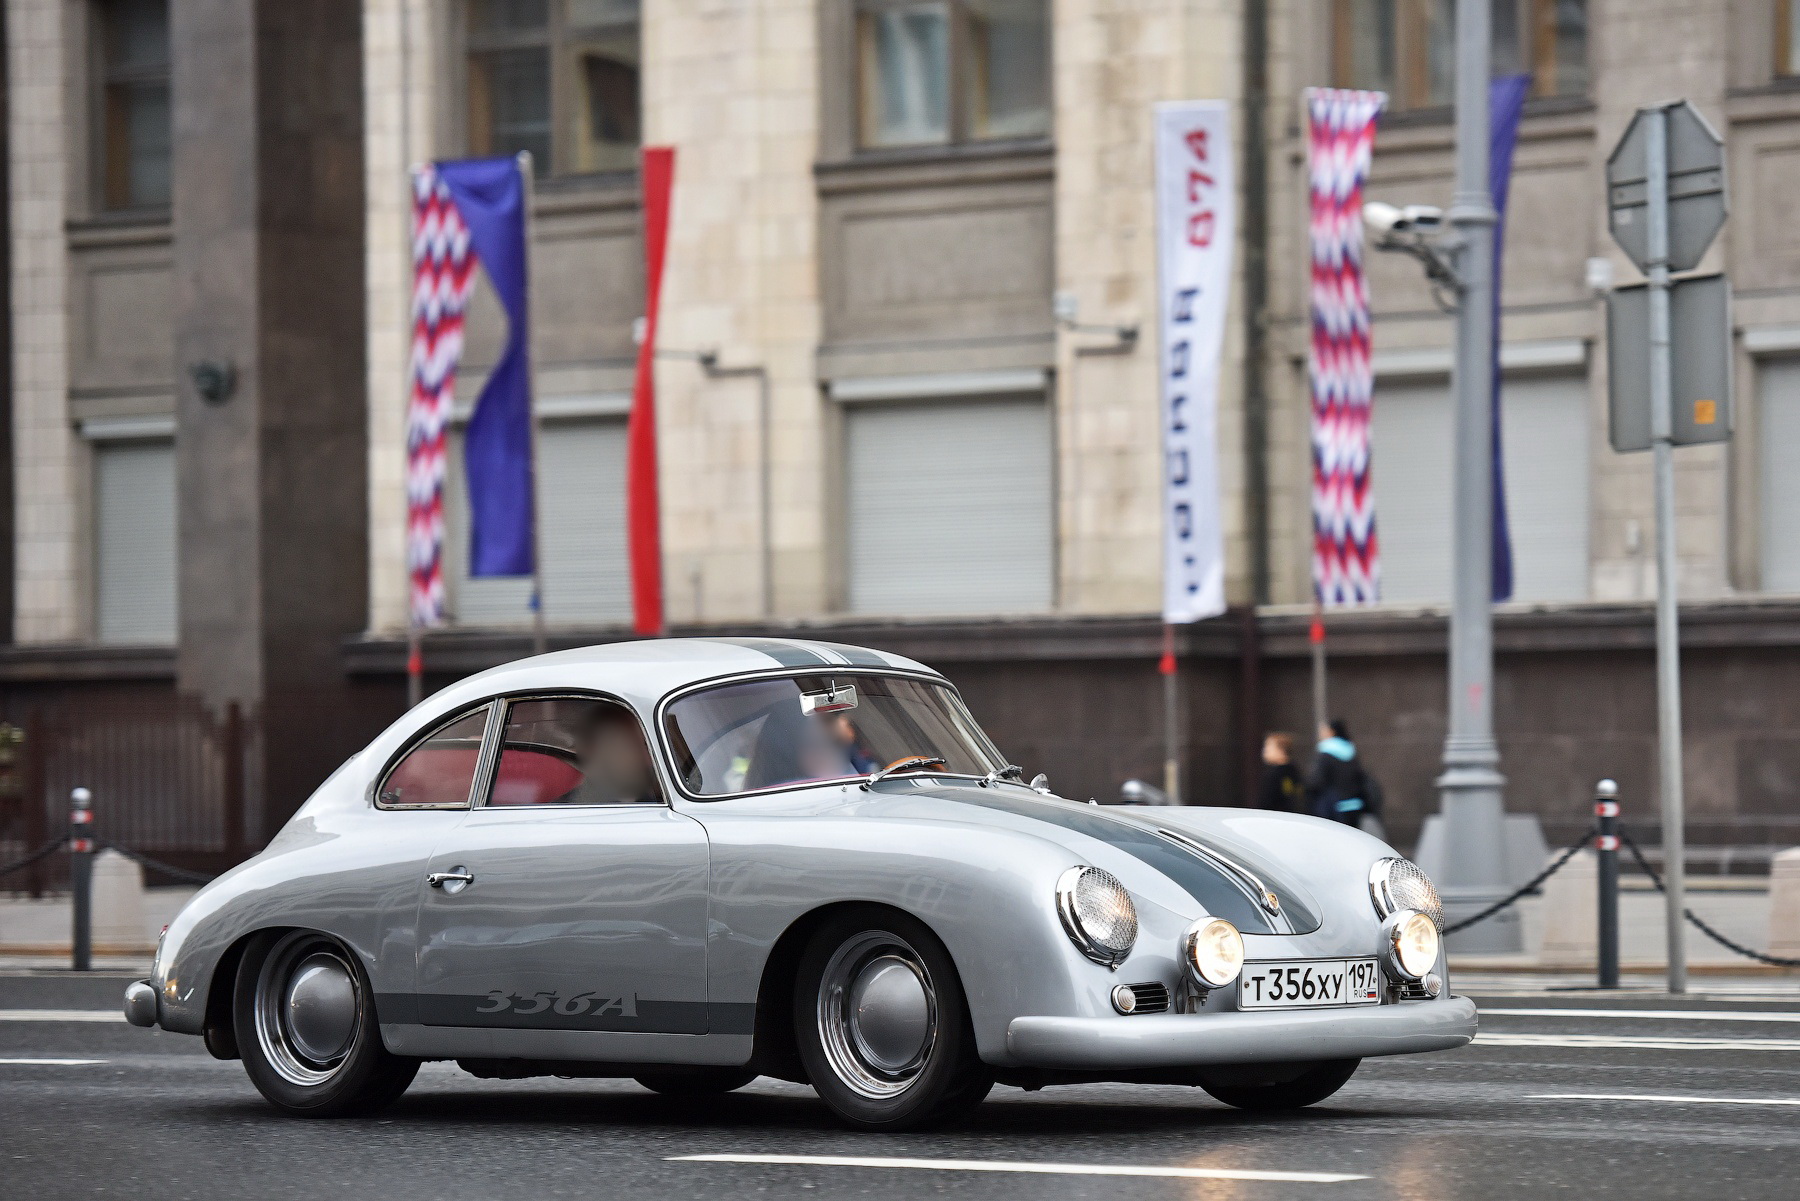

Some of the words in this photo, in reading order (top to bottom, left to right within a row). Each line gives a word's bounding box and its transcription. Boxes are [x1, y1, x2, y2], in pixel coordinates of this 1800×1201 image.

[1252, 968, 1343, 1001] T356XY
[1348, 963, 1373, 988] 197
[1354, 989, 1366, 998] RUS
[476, 989, 639, 1017] 356A
